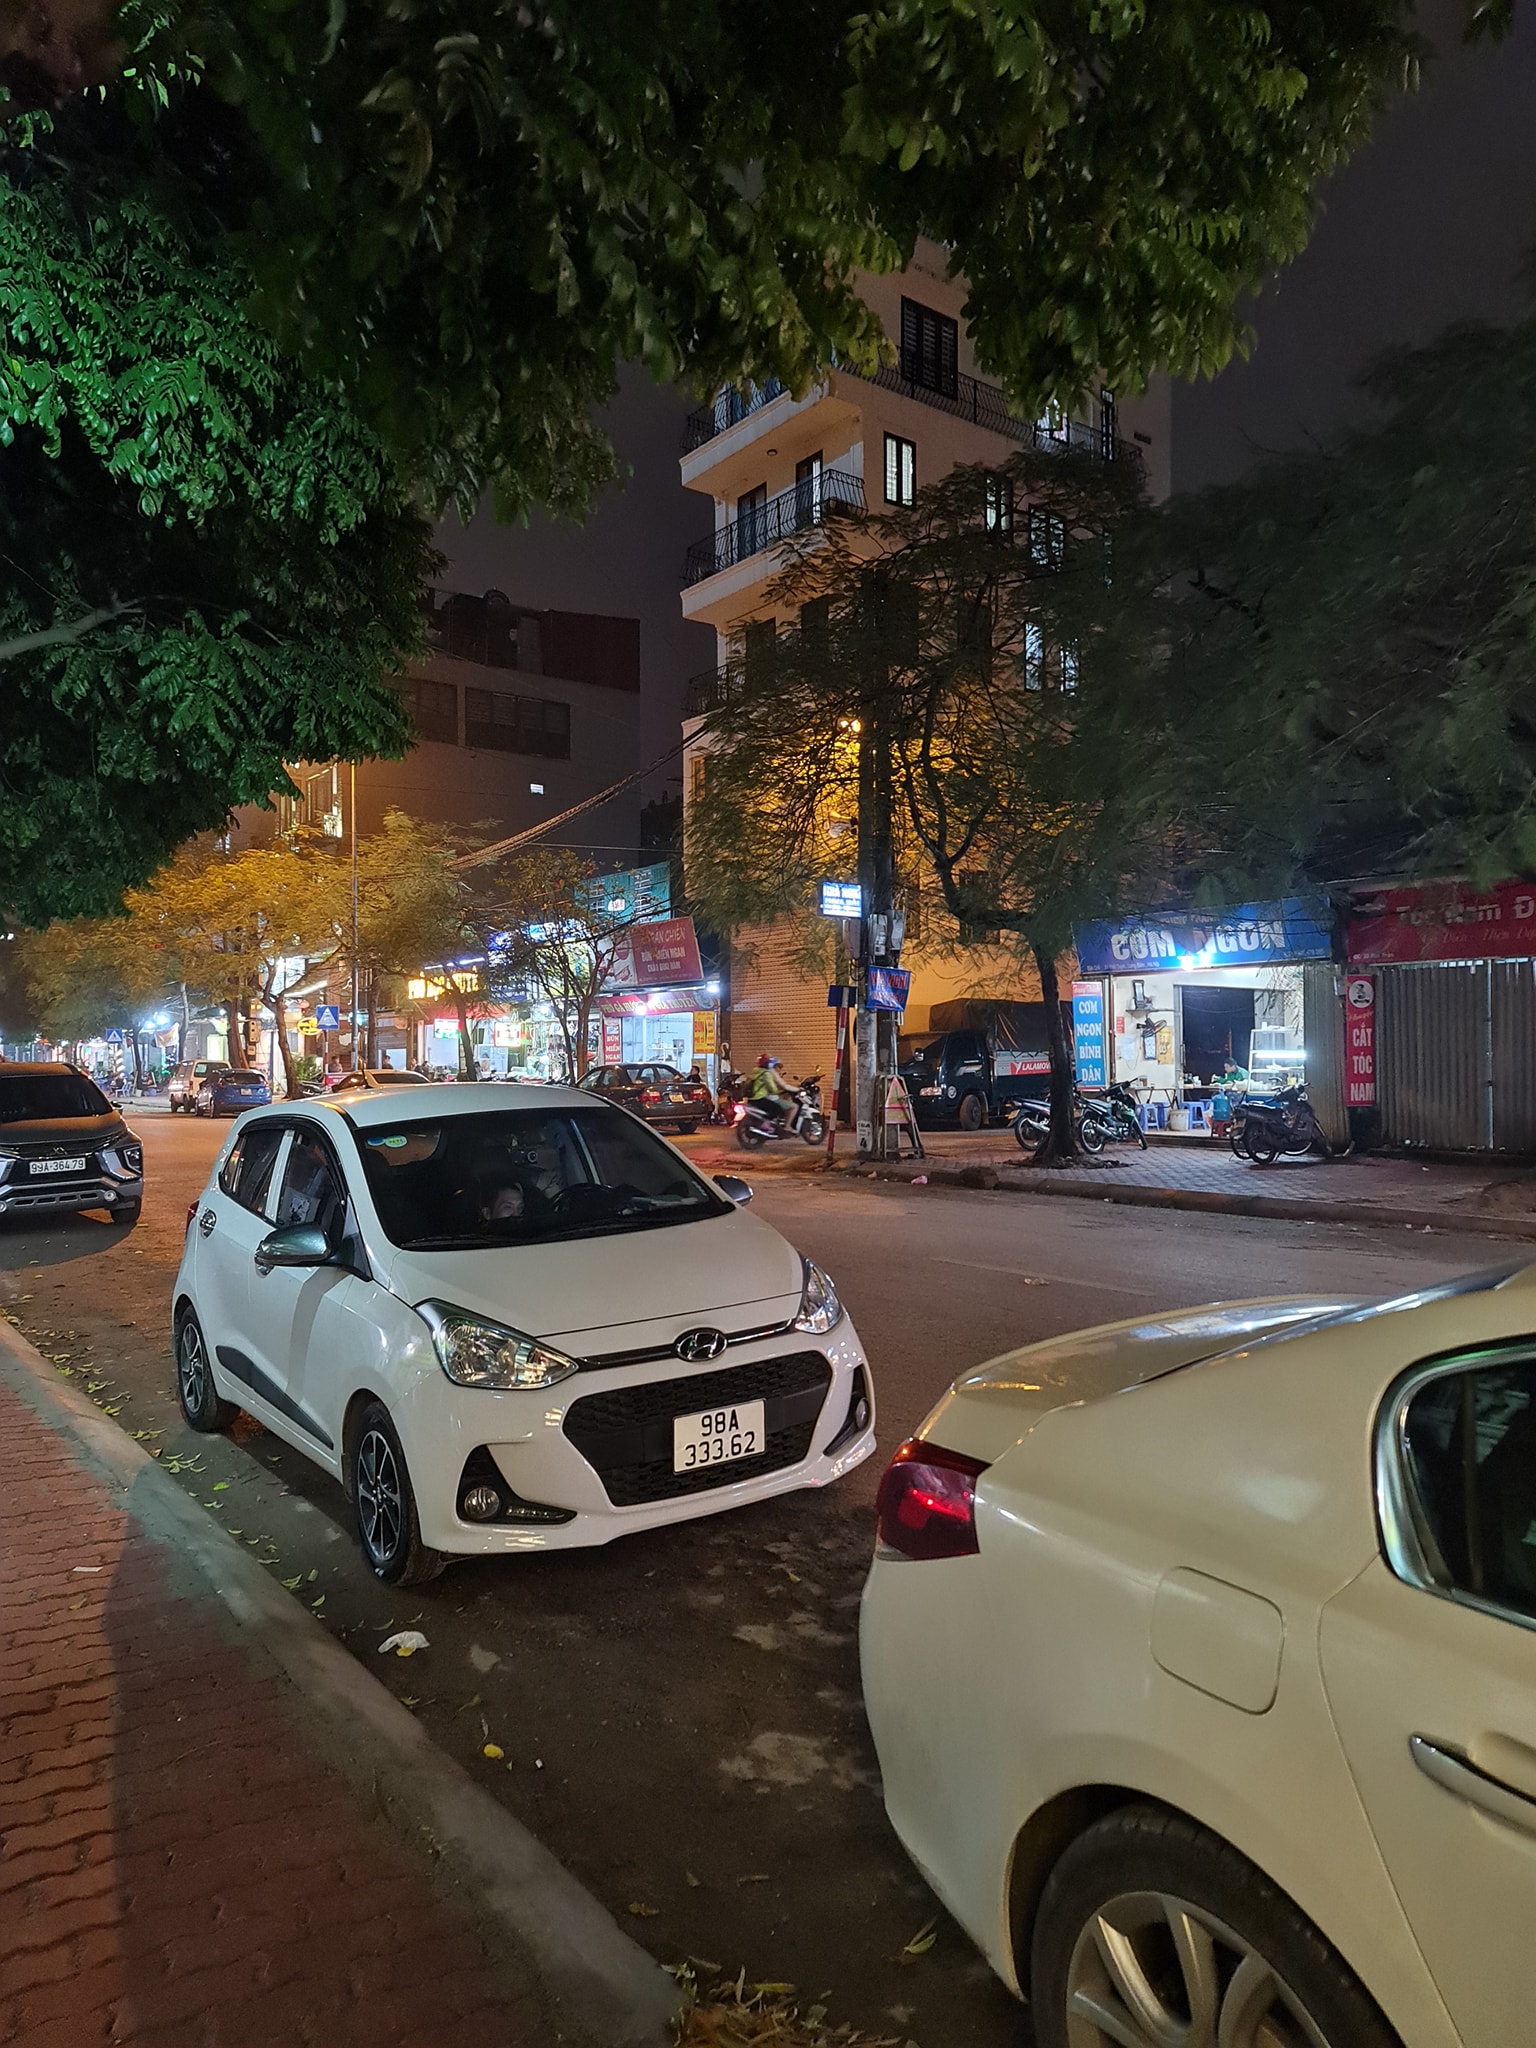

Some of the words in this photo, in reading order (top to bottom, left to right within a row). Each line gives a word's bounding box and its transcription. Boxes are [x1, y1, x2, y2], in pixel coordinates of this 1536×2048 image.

[1078, 1000, 1098, 1014] CƠM
[1076, 1023, 1102, 1037] NGON
[1352, 1022, 1373, 1047] CẮT
[1022, 1062, 1051, 1071] LALAMOV
[1352, 1051, 1373, 1074] TÓC
[1081, 1064, 1101, 1081] DÂN
[1350, 1083, 1375, 1101] NAM
[701, 1409, 739, 1437] 98A
[685, 1431, 755, 1467] 333.62
